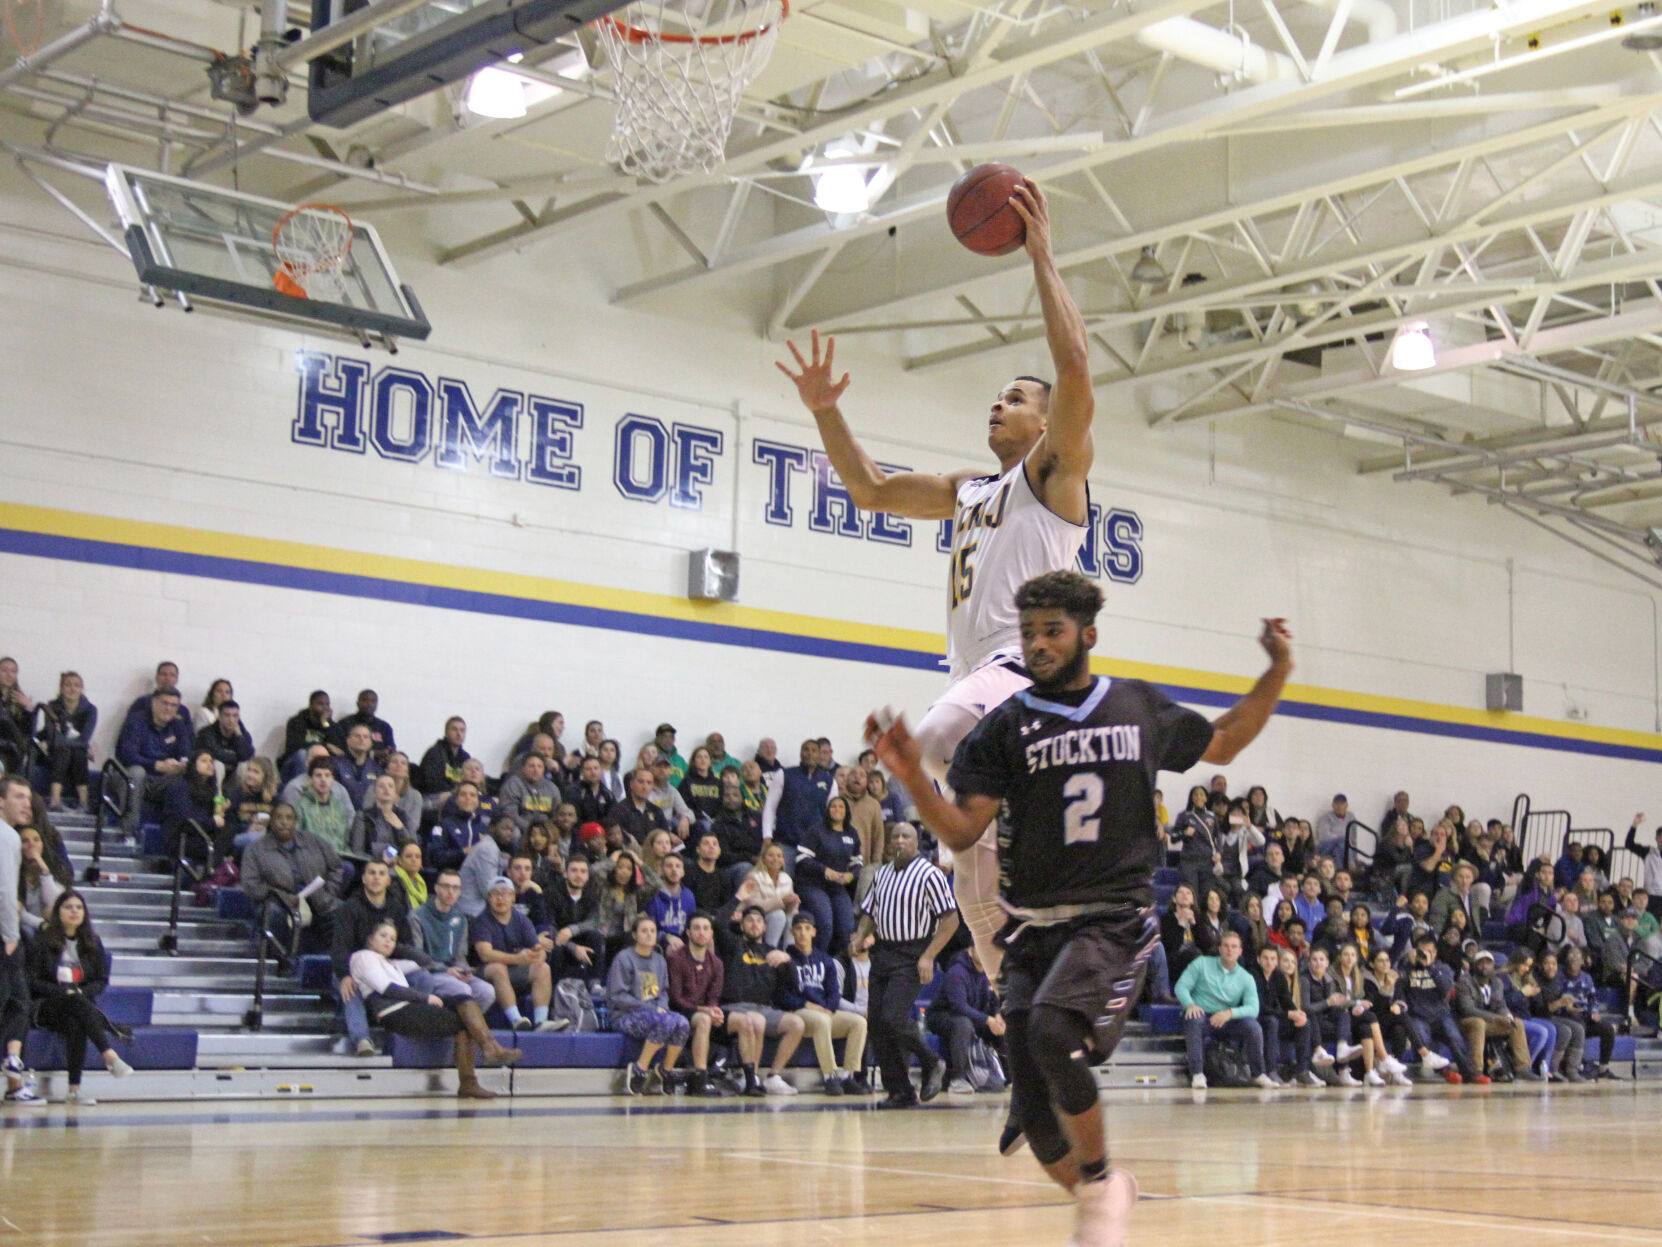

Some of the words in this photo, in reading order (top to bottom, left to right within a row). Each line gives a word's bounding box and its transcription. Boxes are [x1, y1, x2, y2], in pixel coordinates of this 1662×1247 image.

[291, 349, 584, 491] HOME
[613, 412, 724, 511] OF
[951, 541, 978, 611] 15
[1025, 724, 1141, 775] STOCKTON
[1063, 772, 1104, 846] 2
